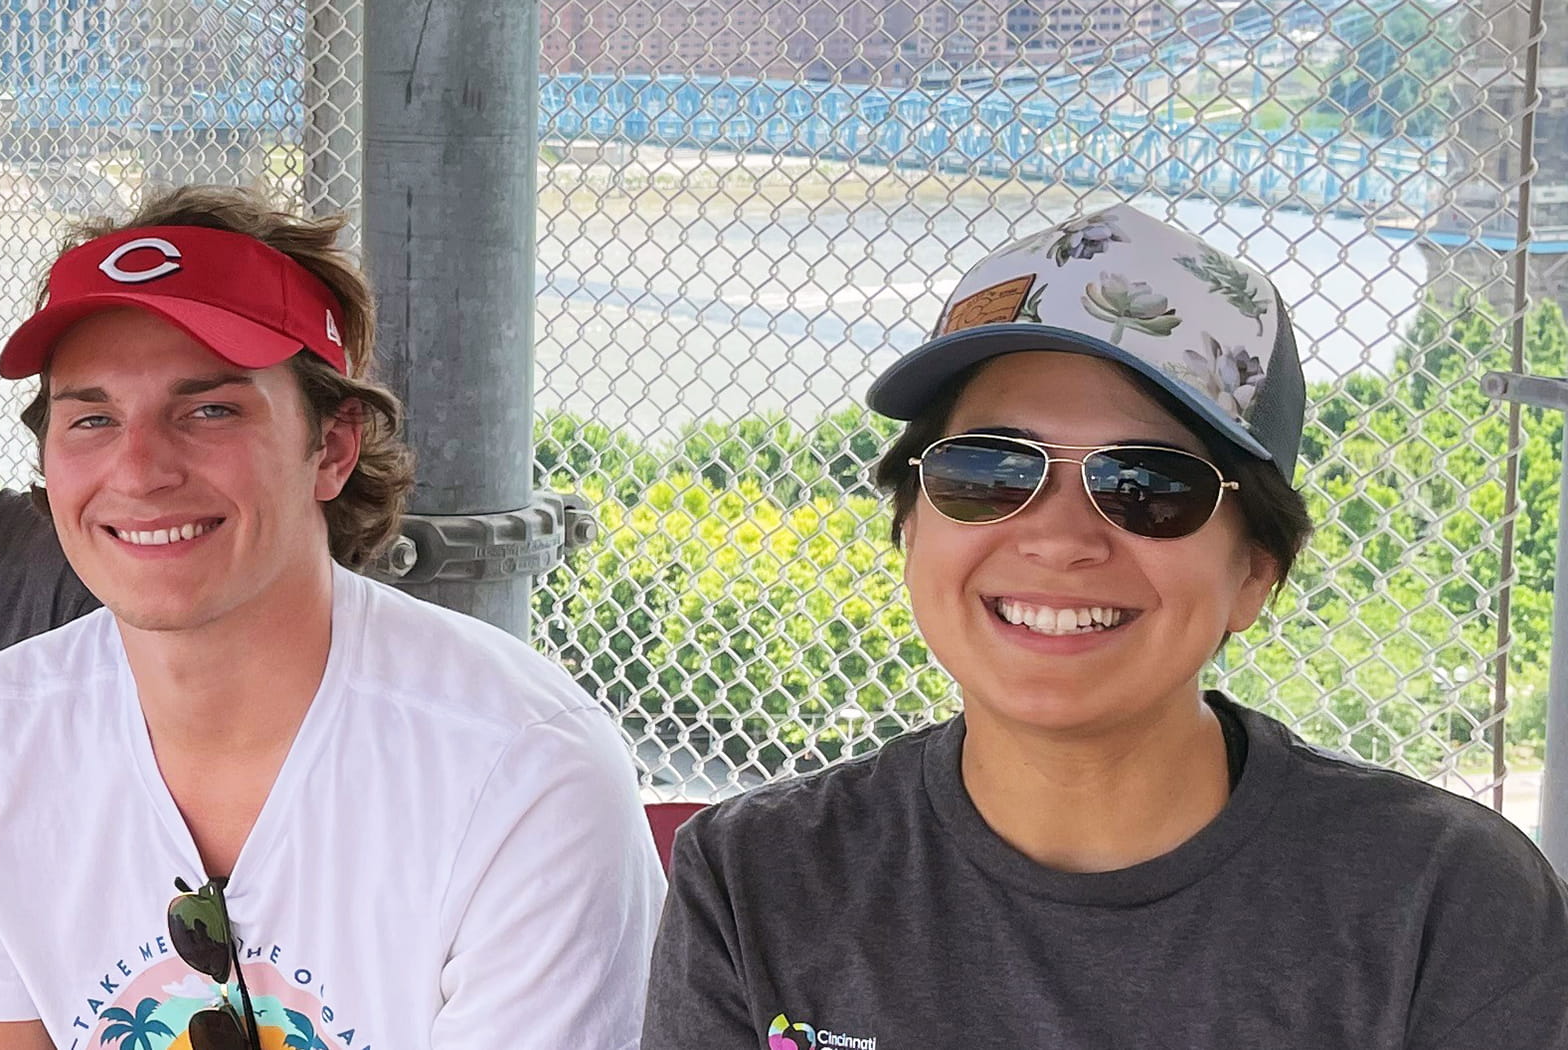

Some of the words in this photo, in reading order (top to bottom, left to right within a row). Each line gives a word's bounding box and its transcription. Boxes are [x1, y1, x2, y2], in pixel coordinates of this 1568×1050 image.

[73, 959, 132, 1030] TAKE
[138, 936, 168, 961] ME
[816, 1029, 877, 1050] Cincinnati
